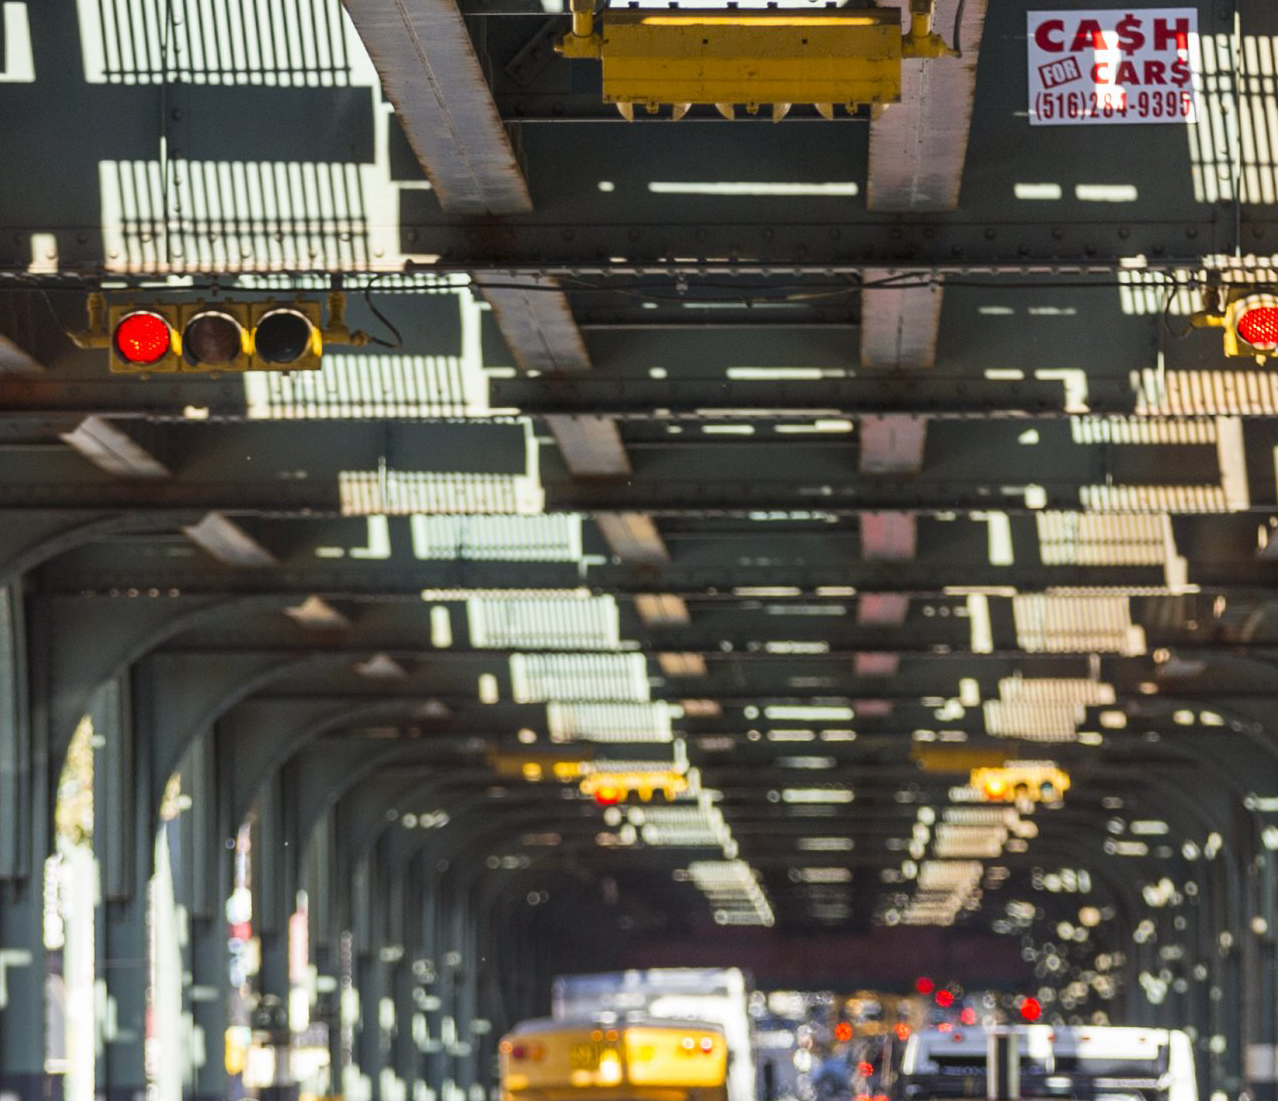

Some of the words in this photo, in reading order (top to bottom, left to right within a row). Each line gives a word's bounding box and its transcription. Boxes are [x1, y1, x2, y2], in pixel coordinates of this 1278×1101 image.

[1034, 14, 1189, 56] CA$H
[1043, 59, 1079, 88] FOR
[1090, 57, 1191, 88] CAR$
[1035, 91, 1190, 121] (516)284-9395
